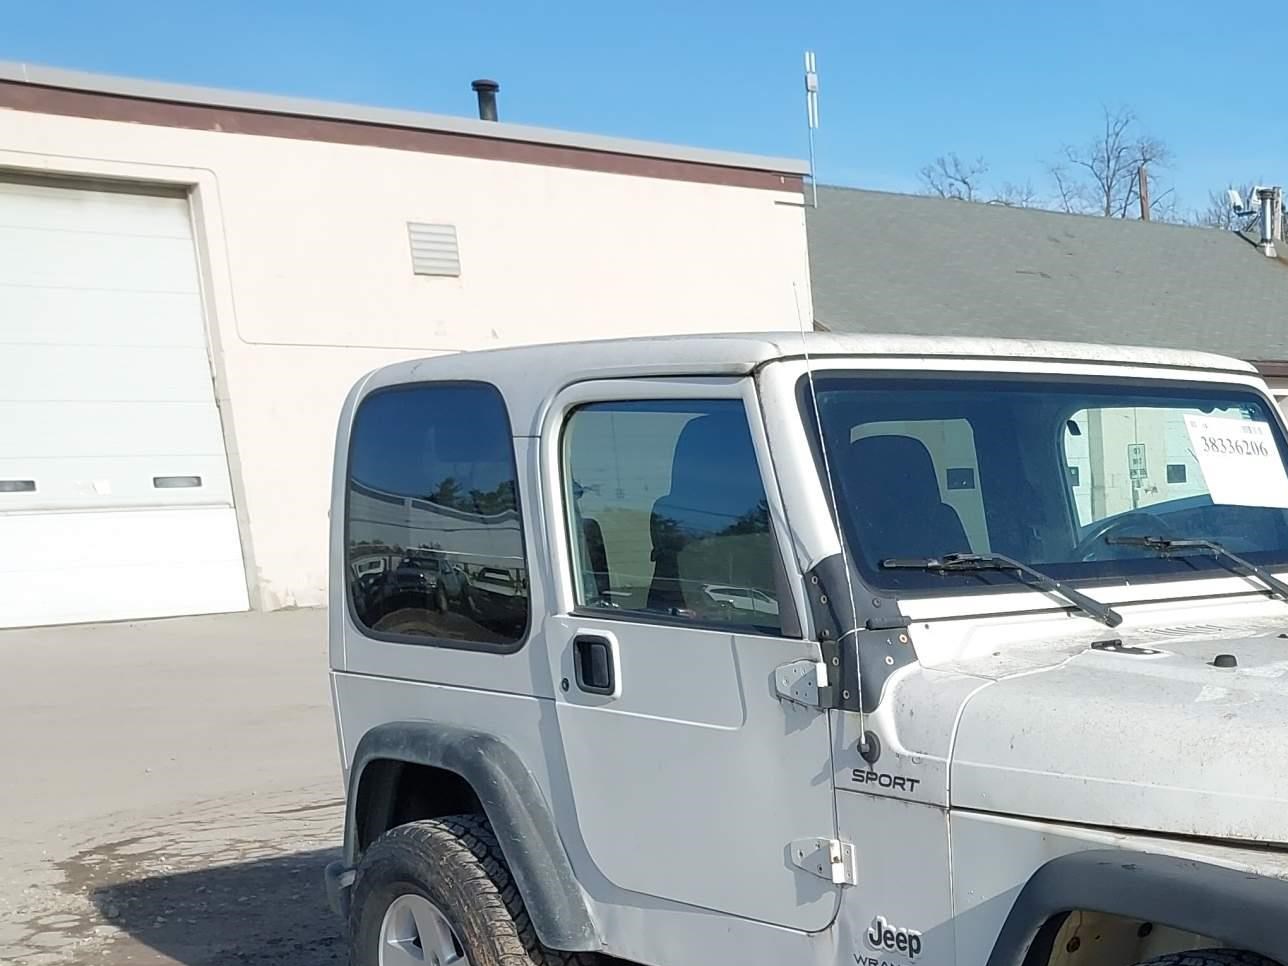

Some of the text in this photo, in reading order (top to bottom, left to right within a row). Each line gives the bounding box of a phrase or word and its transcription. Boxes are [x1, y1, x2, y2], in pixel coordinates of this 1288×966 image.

[1201, 435, 1269, 456] 38336206
[851, 768, 921, 793] SPORT
[868, 920, 922, 958] Jeep
